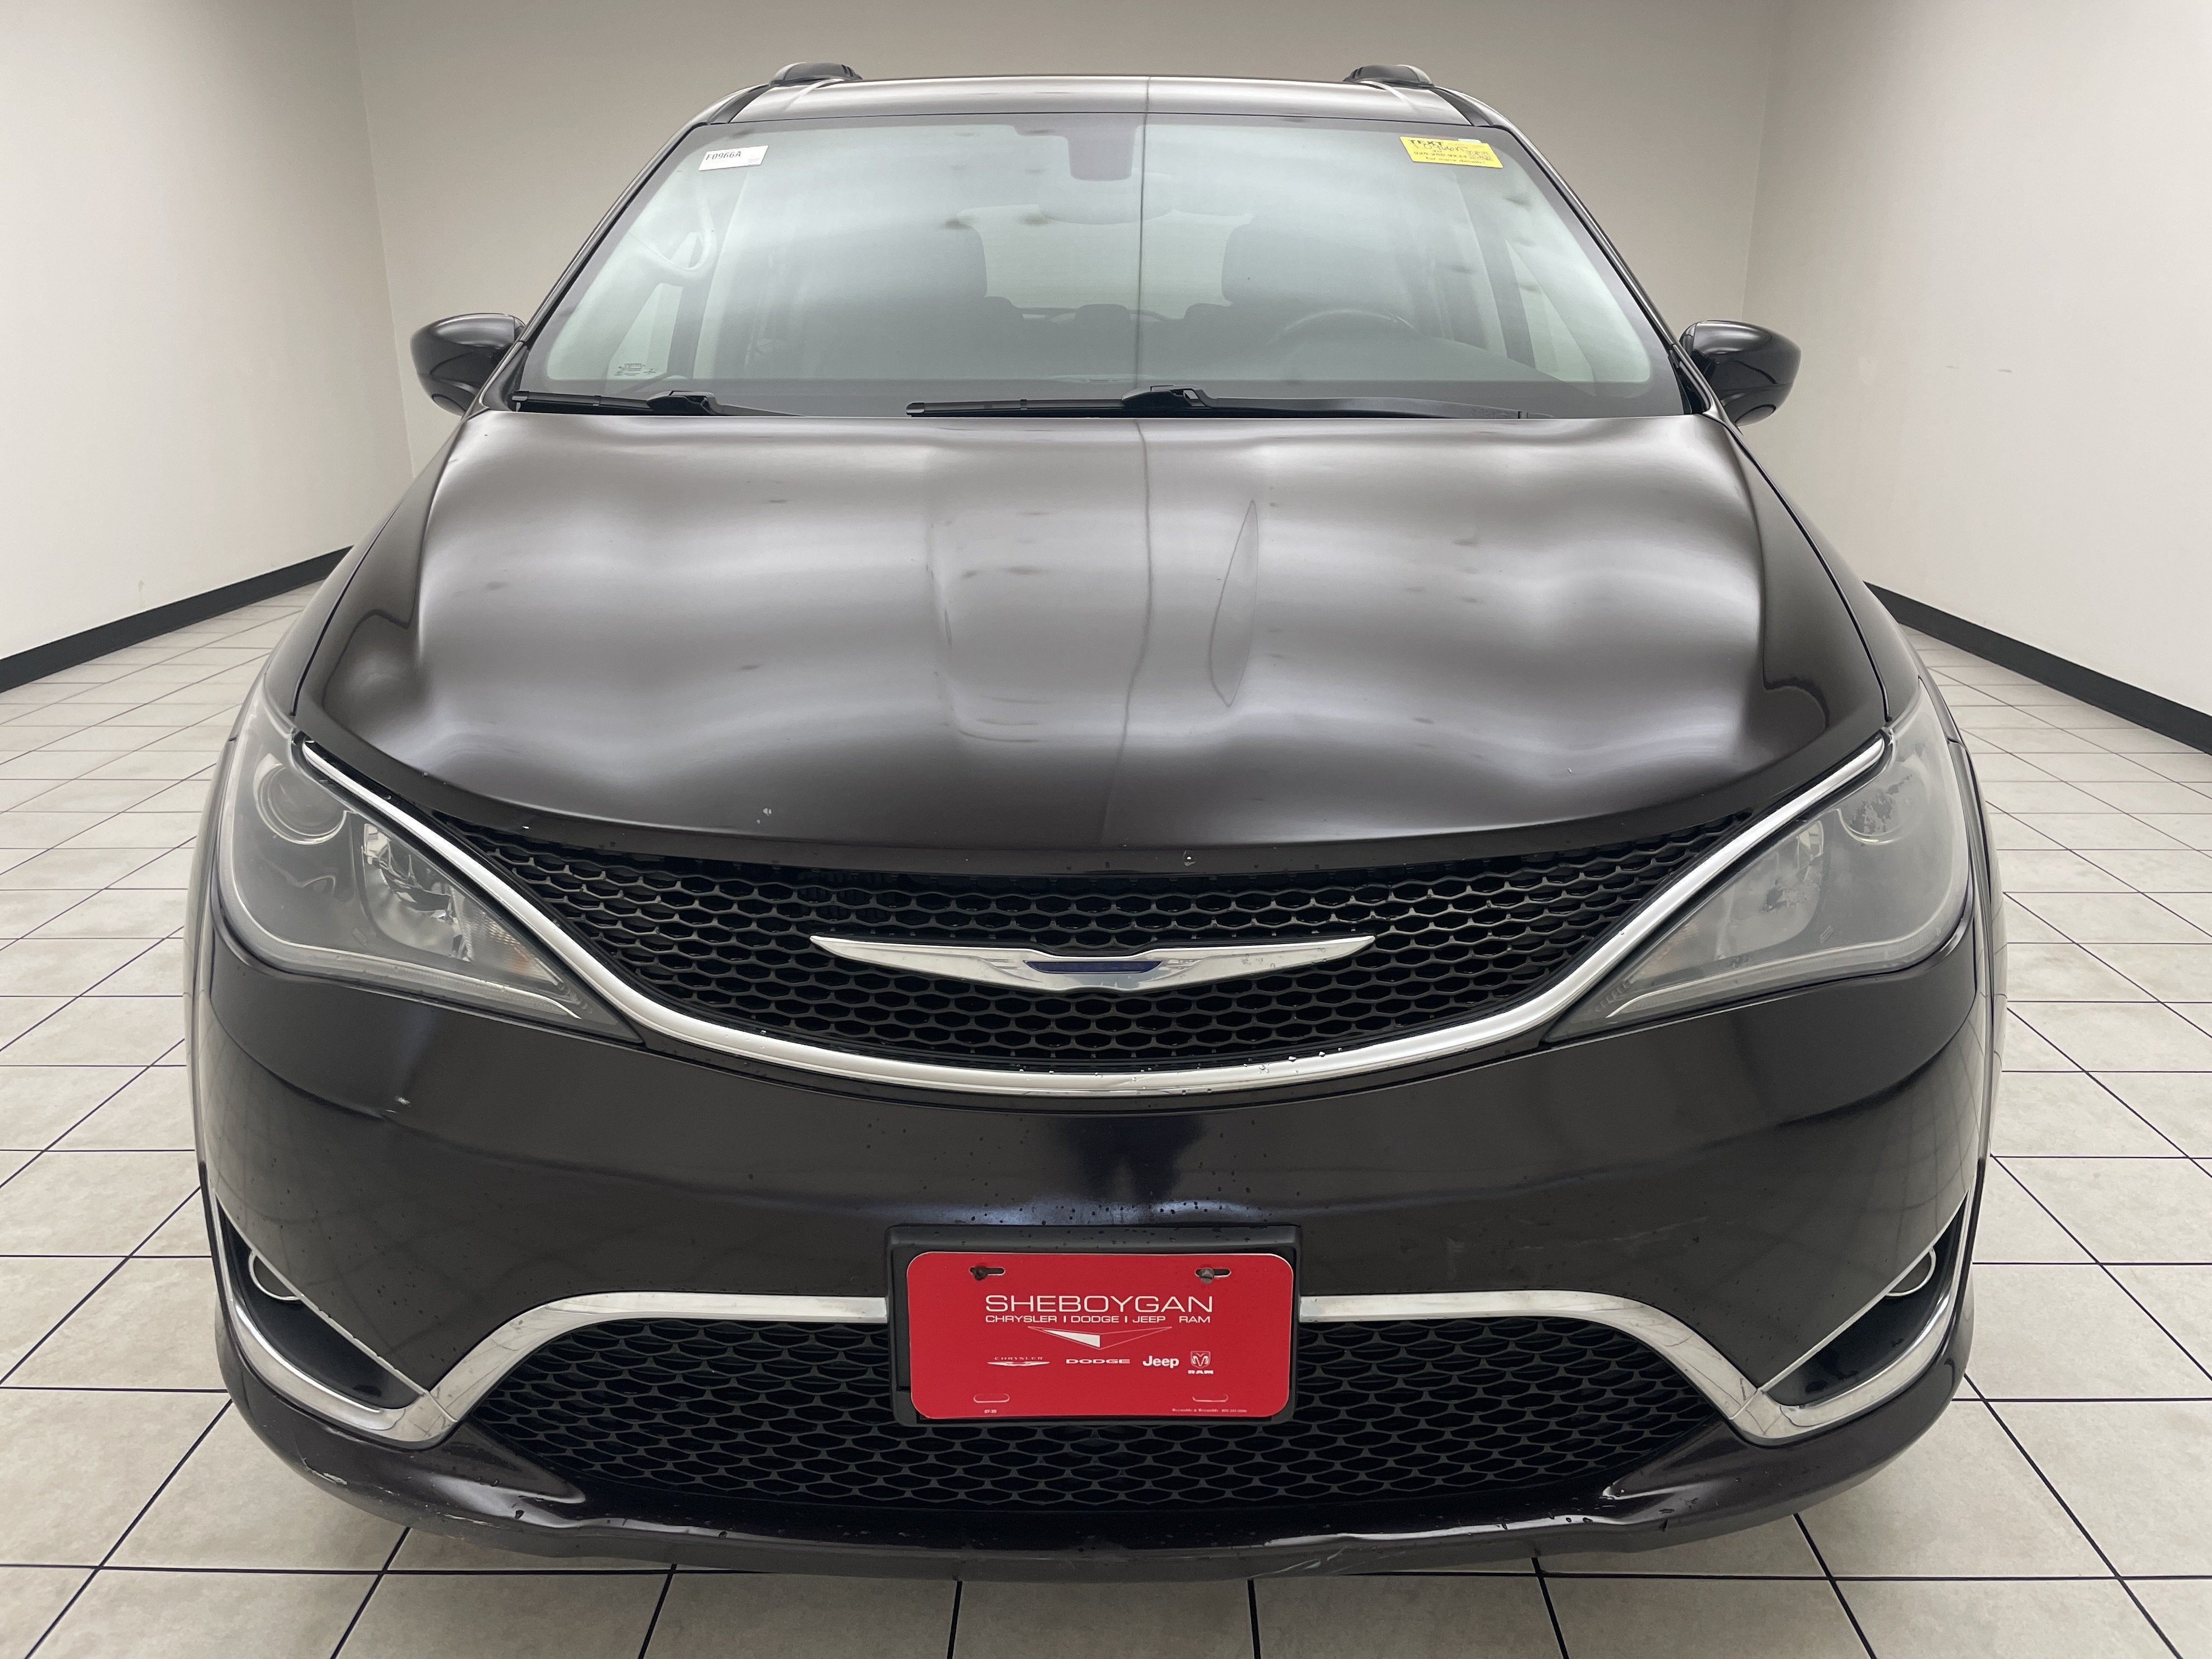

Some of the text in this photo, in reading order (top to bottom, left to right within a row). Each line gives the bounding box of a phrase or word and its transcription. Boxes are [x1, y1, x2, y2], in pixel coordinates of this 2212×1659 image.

[985, 1294, 1213, 1313] SHEBOYGAN
[985, 1315, 1058, 1323] CHRYSLER
[1179, 1316, 1211, 1324] RAM
[1142, 1355, 1180, 1369] Jeep
